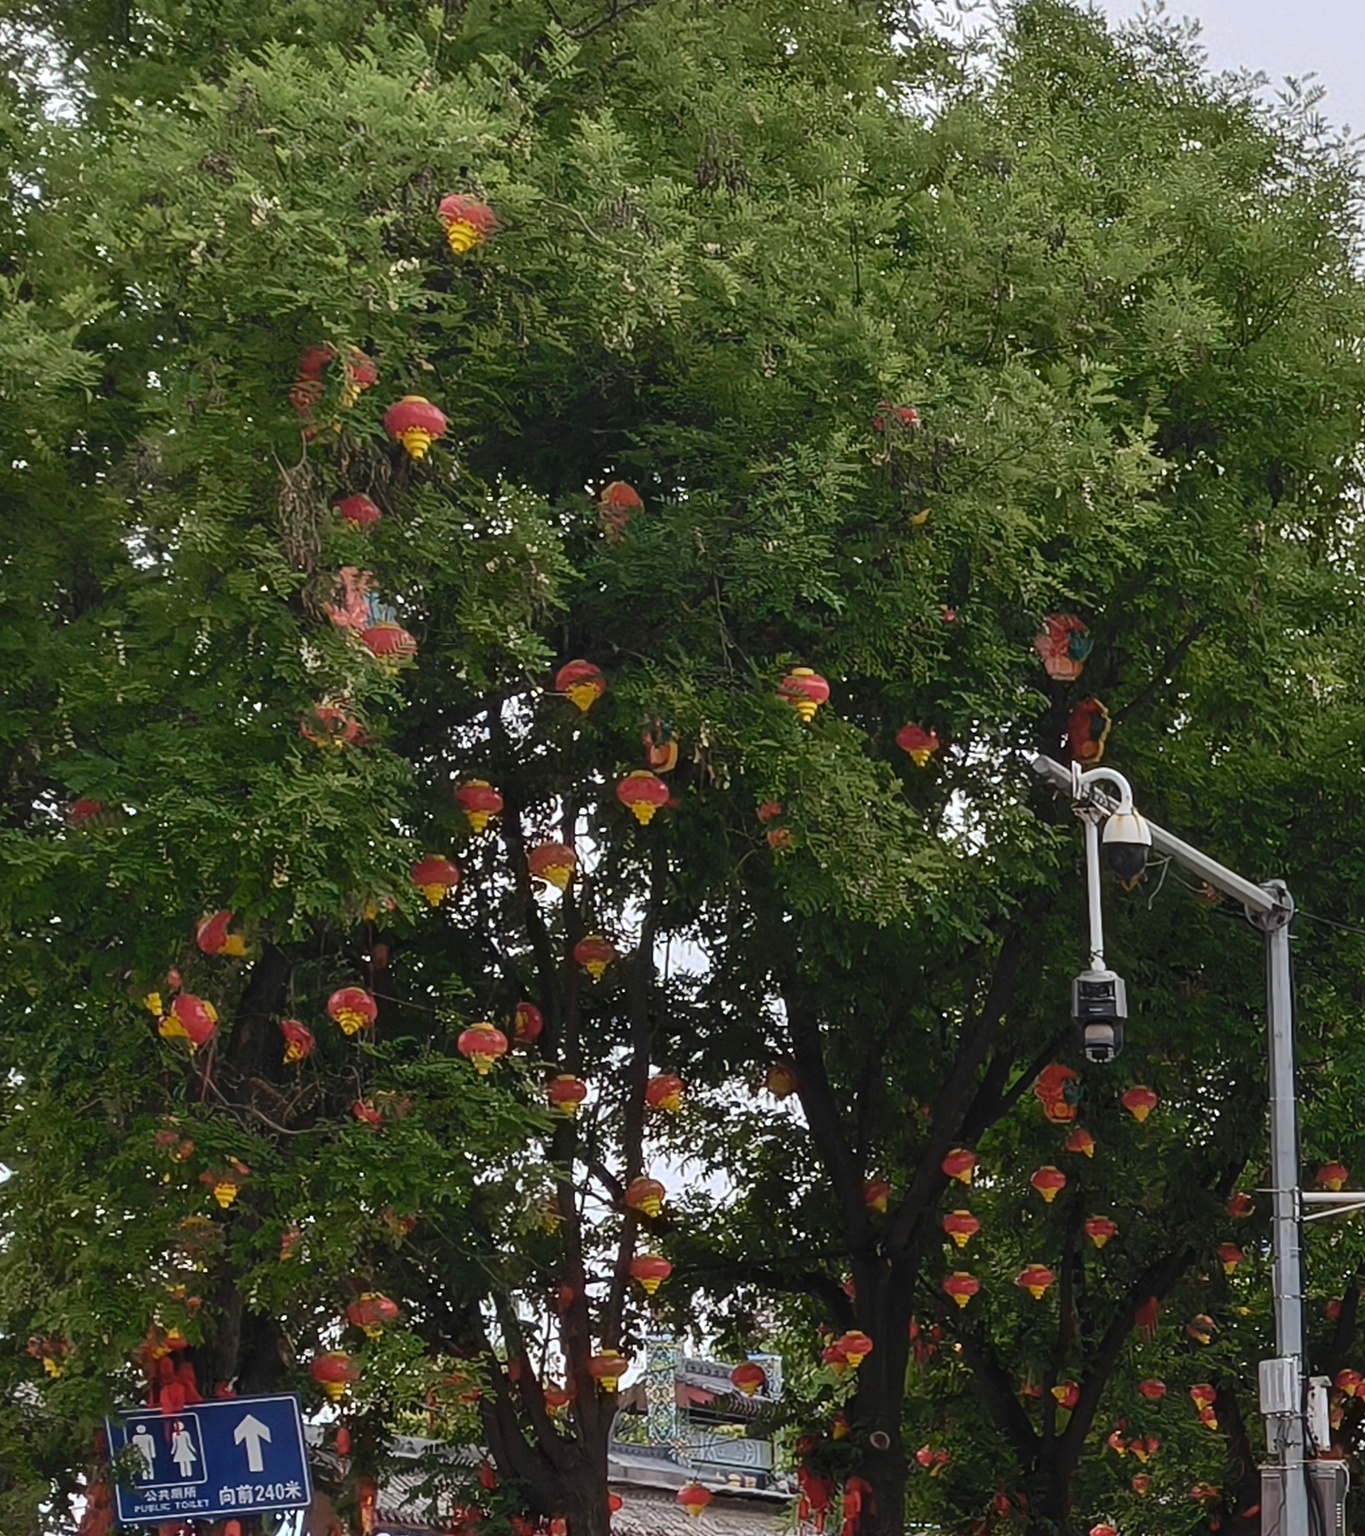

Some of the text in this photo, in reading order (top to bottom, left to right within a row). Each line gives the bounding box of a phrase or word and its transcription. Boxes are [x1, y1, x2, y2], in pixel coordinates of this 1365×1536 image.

[144, 1486, 197, 1502] 公共厕所
[219, 1480, 302, 1506] 向前240米
[134, 1499, 210, 1513] PUBLIC TOILET
